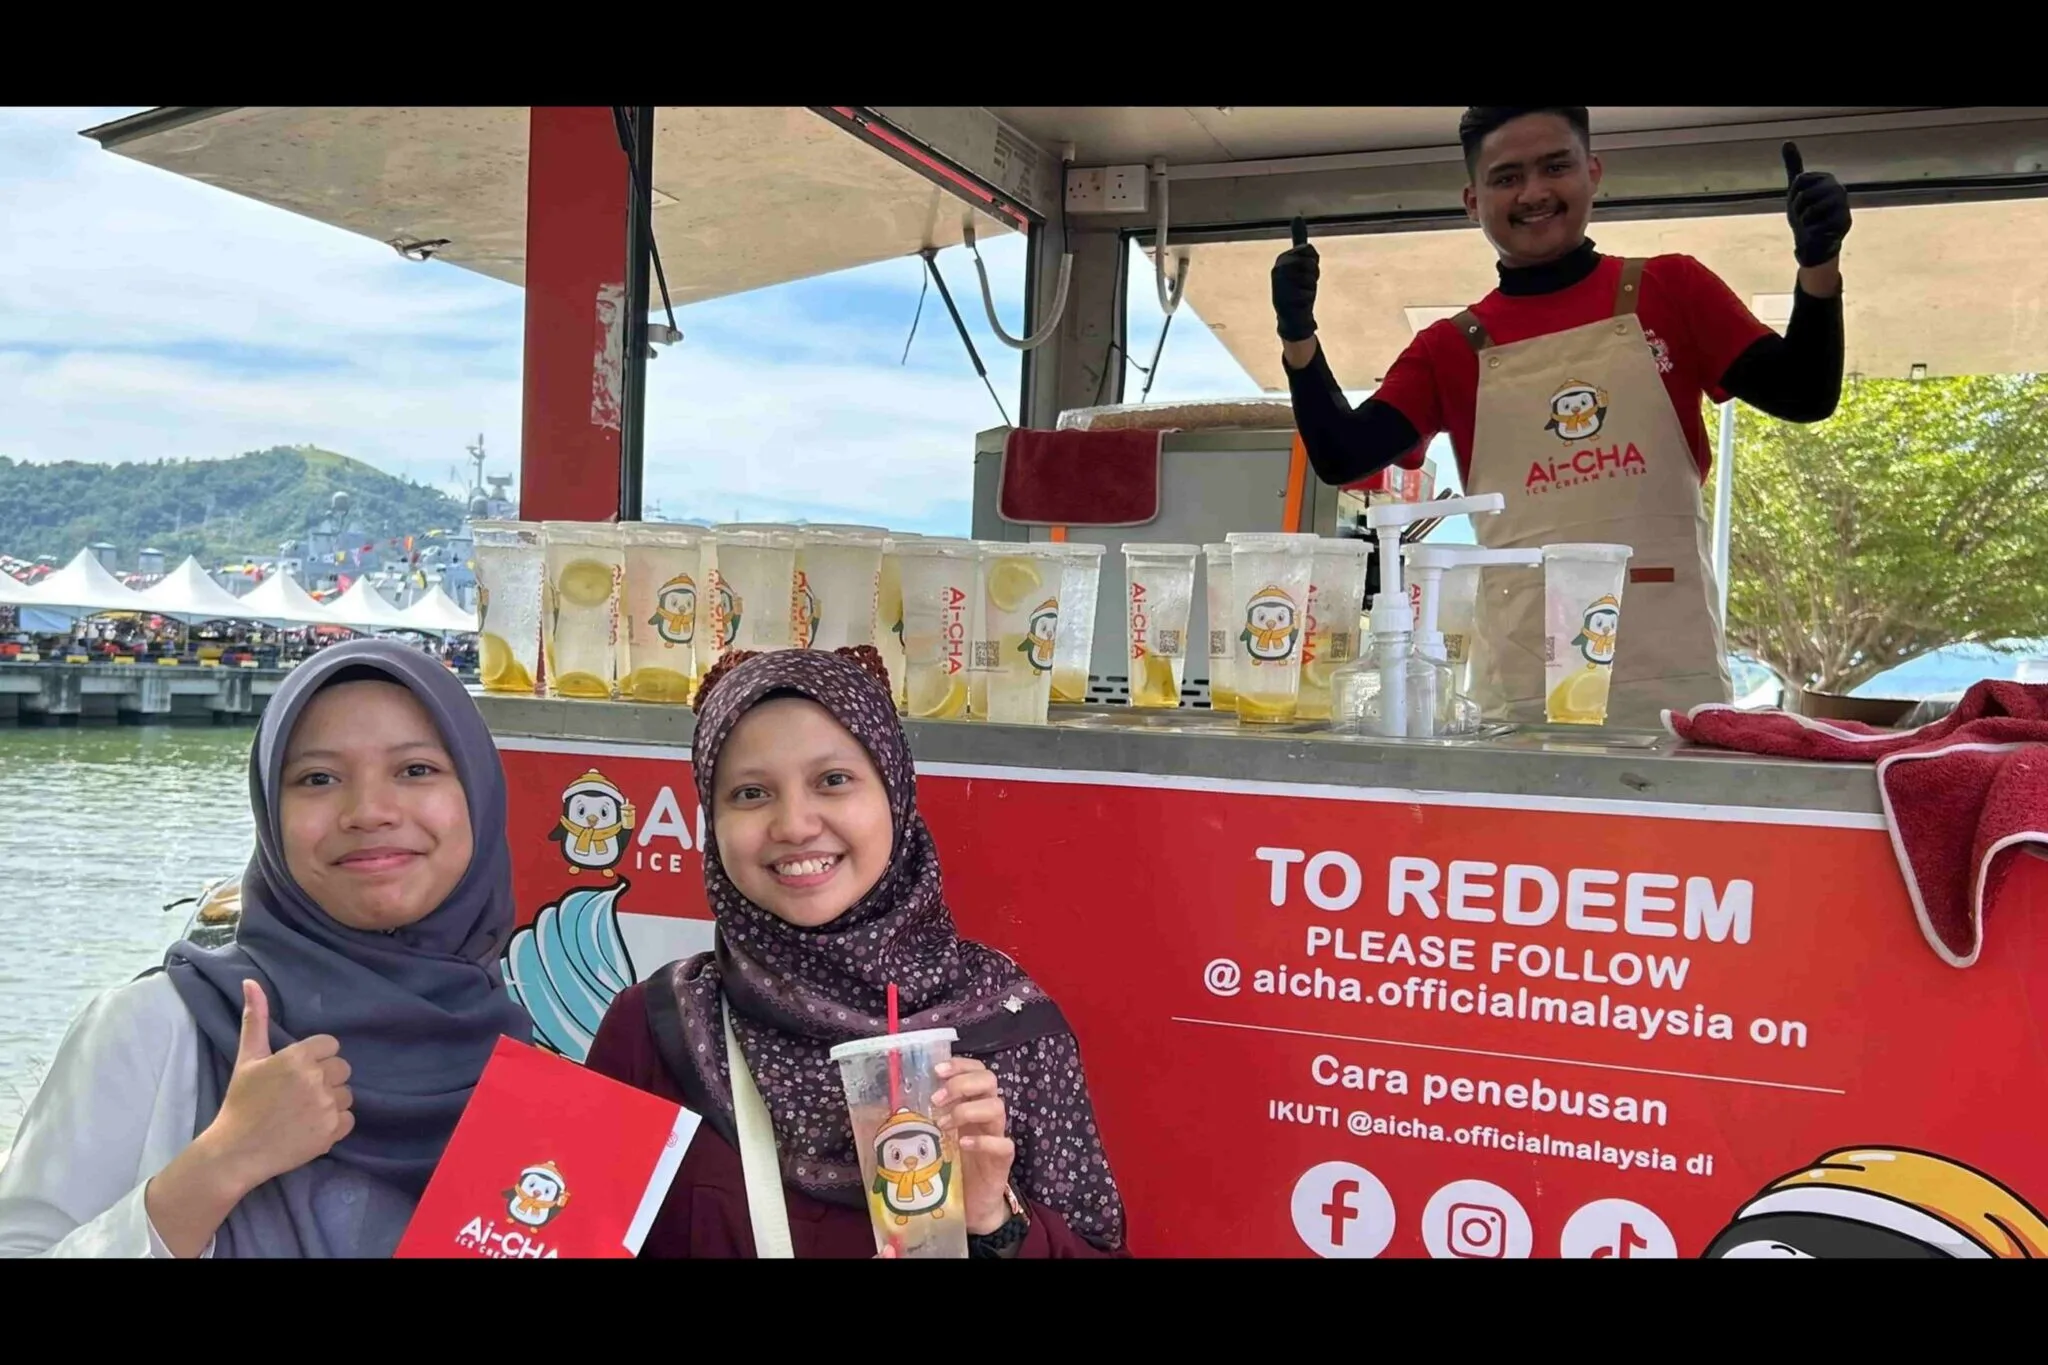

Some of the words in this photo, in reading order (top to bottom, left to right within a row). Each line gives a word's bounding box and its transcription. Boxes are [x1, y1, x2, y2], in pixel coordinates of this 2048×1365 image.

[1526, 442, 1645, 487] Ai-CHA
[1526, 485, 1548, 496] ICE
[1555, 473, 1600, 490] CREAM
[1624, 467, 1647, 477] TEA
[948, 587, 966, 675] Ai-CHA
[1132, 582, 1147, 660] Ai-CHA
[636, 851, 682, 873] ICE
[1255, 847, 1363, 911] TO
[1387, 855, 1755, 945] REDEEM
[1306, 926, 1476, 972] PLEASE
[1490, 941, 1692, 991] FOLLOW
[1203, 957, 1242, 997] @
[1253, 963, 1734, 1042] aicha.officialmalaysia
[1749, 1017, 1809, 1049] on
[1310, 1054, 1410, 1096] Cara
[1423, 1073, 1668, 1127] penebusan
[1269, 1100, 1340, 1129] IKUTI
[1346, 1109, 1678, 1173] @aicha.officialmalaysia
[1685, 1153, 1714, 1177] di
